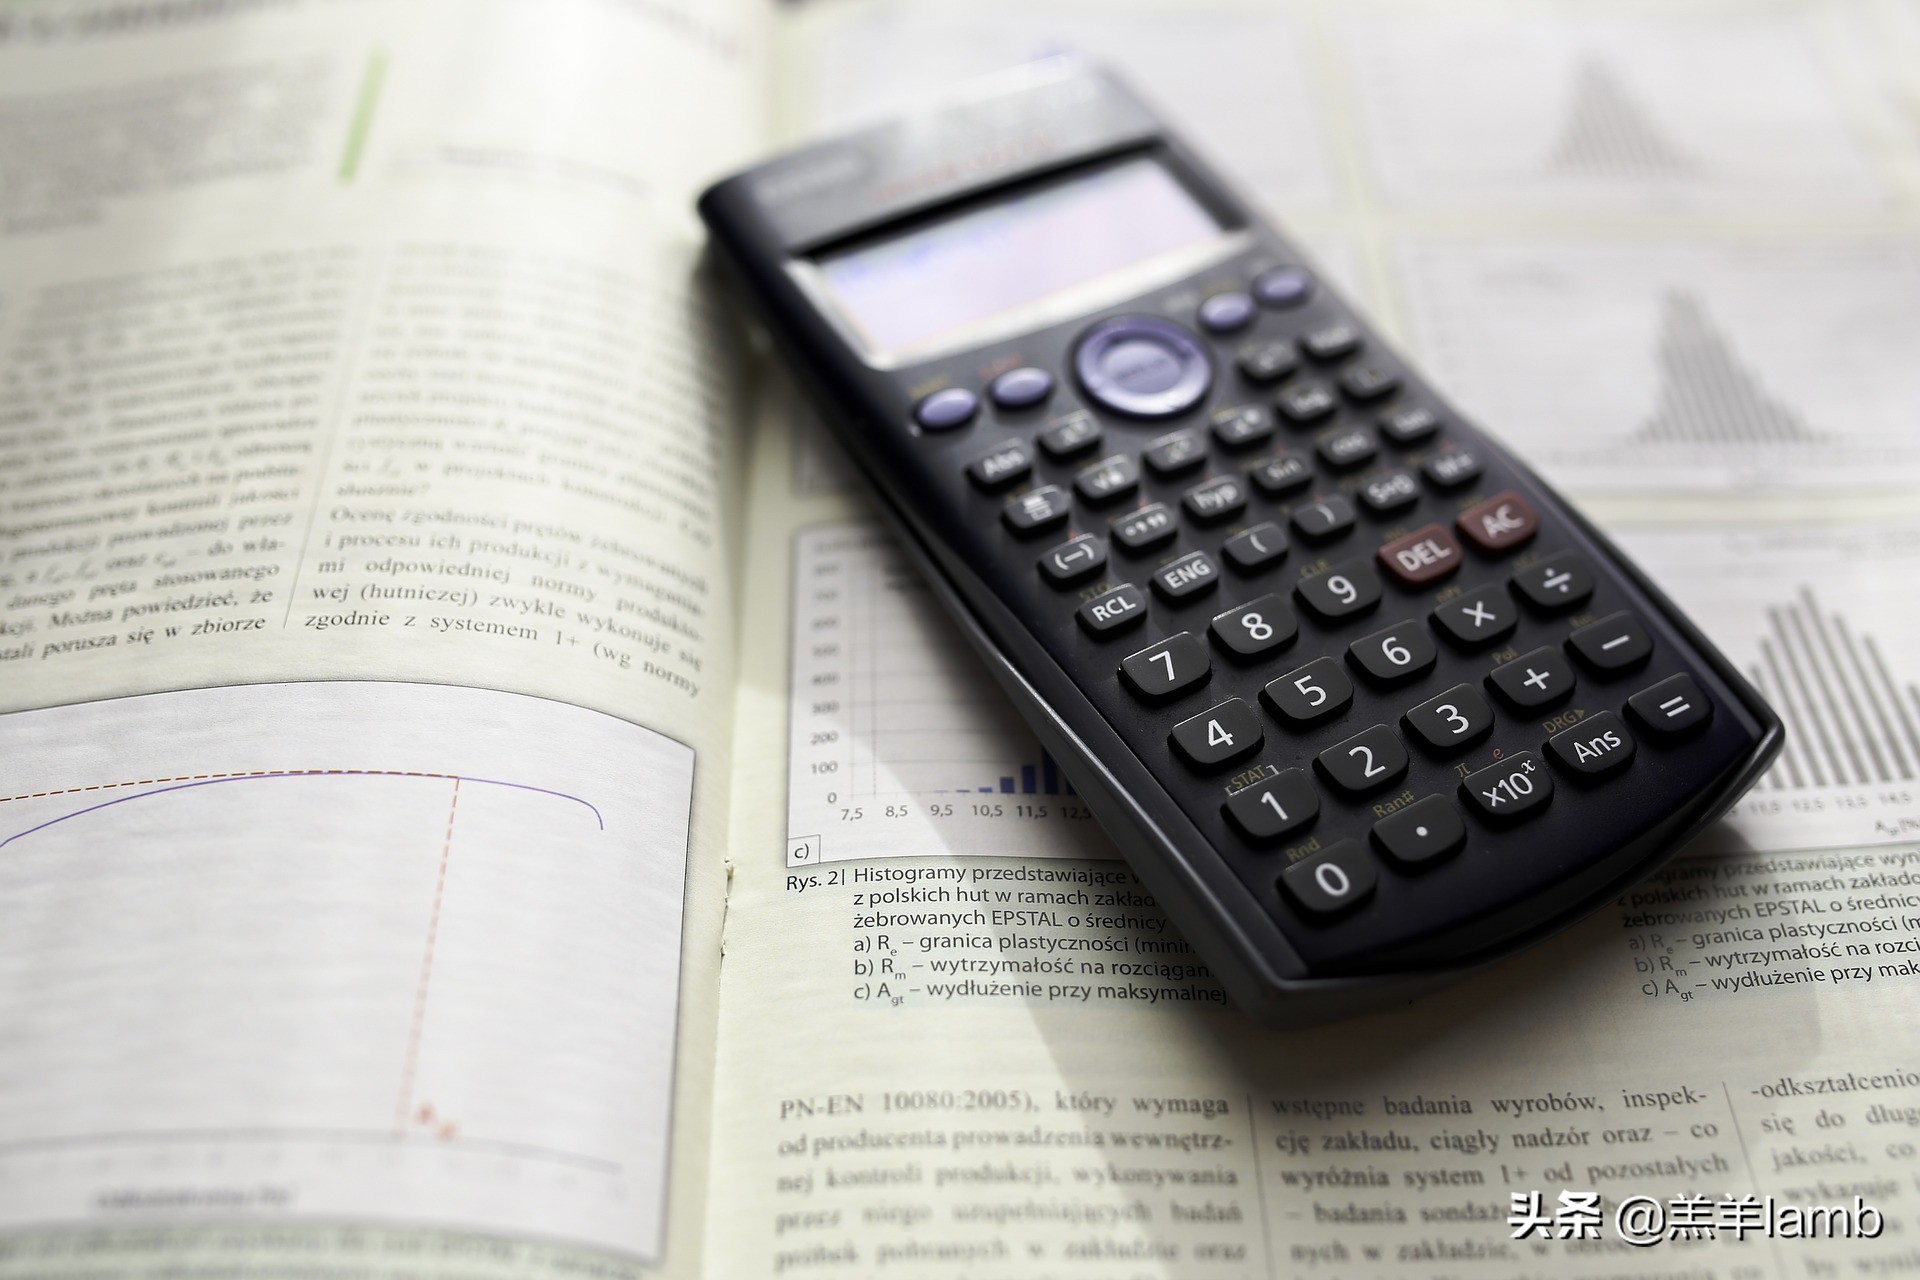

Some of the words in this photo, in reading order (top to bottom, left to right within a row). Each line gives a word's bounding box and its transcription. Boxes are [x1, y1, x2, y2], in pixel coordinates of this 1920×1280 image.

[331, 505, 395, 523] Ocenę
[401, 508, 507, 528] zgodności
[513, 520, 581, 543] prętów
[1482, 504, 1524, 539] AC
[324, 531, 332, 547] i
[338, 533, 421, 551] procesu
[430, 531, 461, 549] ich
[469, 539, 569, 567] produkcji
[1397, 538, 1450, 572] DEL
[152, 564, 280, 589] stosowanego
[318, 558, 346, 573] mi
[365, 557, 511, 584] odpowiedniej
[531, 575, 597, 602] normy
[1164, 559, 1211, 590] ENG
[1327, 575, 1357, 604] 9
[49, 607, 113, 628] Można
[122, 590, 239, 622] powiedzieć,
[249, 588, 274, 605] że
[1091, 596, 1137, 623] RCL
[41, 633, 117, 660] porusza
[126, 626, 155, 645] się
[165, 625, 182, 638] w
[191, 616, 266, 636] zbiorze
[313, 582, 349, 603] wej
[361, 583, 478, 606] (hutniczej)
[489, 596, 566, 618] zwykle
[576, 612, 671, 654] wykonuje
[679, 649, 703, 672] się
[1241, 612, 1273, 640] 8
[305, 610, 390, 630] zgodnie
[405, 615, 416, 627] z
[430, 615, 538, 641] systemem
[556, 631, 579, 647] 1+
[593, 642, 631, 668] (wg
[642, 659, 699, 698] normy
[1149, 650, 1176, 682] 7
[1381, 636, 1412, 666] 6
[1293, 675, 1327, 707] 5
[1208, 719, 1234, 747] 4
[1435, 704, 1470, 734] 3
[811, 731, 838, 745] 200
[1573, 730, 1622, 764] Ans
[811, 762, 838, 774] 100
[1348, 745, 1386, 778] 2
[827, 792, 837, 803] 0
[1261, 791, 1288, 820] 1
[1372, 789, 1415, 819] Ran#
[840, 807, 863, 822] 7,5
[885, 805, 908, 818] 8,5
[930, 804, 953, 817] 9,5
[971, 804, 1003, 818] 10,5
[1016, 804, 1048, 819] 11,5
[794, 843, 810, 859] c)
[1286, 838, 1321, 862] Rnd
[786, 875, 822, 893] Rys.
[854, 867, 966, 883] Histogramy
[972, 866, 1126, 886] przedstawiające
[1314, 862, 1350, 896] 0
[1724, 854, 1875, 880] przedstawiające
[853, 894, 864, 905] z
[870, 887, 950, 908] polskich
[957, 887, 989, 902] hut
[995, 890, 1011, 903] w
[1018, 890, 1089, 905] ramach
[1631, 887, 1710, 908] polskich
[1713, 884, 1749, 898] hut
[1752, 885, 1768, 897] w
[1774, 876, 1846, 895] ramach
[853, 909, 986, 928] żebrowanych
[992, 910, 1062, 927] EPSTAL
[1068, 915, 1080, 928] o
[1086, 912, 1167, 934] średnicy
[1622, 903, 1751, 928] żebrowanych
[1755, 900, 1826, 918] EPSTAL
[1830, 900, 1843, 912] o
[854, 936, 871, 953] a)
[919, 933, 993, 953] granica
[1000, 933, 1129, 954] plastyczności
[1628, 935, 1646, 951] a)
[1692, 927, 1764, 949] granica
[1768, 916, 1898, 943] plastyczności
[854, 959, 874, 977] b)
[930, 957, 1074, 976] wytrzymałość
[1081, 962, 1104, 975] na
[1634, 957, 1655, 974] b)
[1705, 942, 1842, 970] wytrzymałość
[1845, 944, 1870, 957] na
[854, 983, 871, 1001] c)
[927, 980, 1042, 1000] wydłużenie
[1050, 985, 1091, 1001] przy
[1098, 983, 1228, 1006] maksymalnej
[1642, 980, 1658, 997] c)
[1711, 967, 1826, 993] wydłużenie
[1830, 966, 1872, 984] przy
[780, 1093, 863, 1120] PN-EN
[884, 1088, 1039, 1112] 10080:2005),
[1055, 1090, 1116, 1118] który
[1132, 1096, 1229, 1120] wymaga
[1273, 1099, 1364, 1120] wstępne
[1384, 1094, 1472, 1116] badania
[1491, 1092, 1604, 1118] wyrobów,
[1622, 1086, 1707, 1111] inspek-
[1761, 1113, 1795, 1136] się
[1815, 1109, 1845, 1129] do
[778, 1133, 807, 1157] od
[813, 1129, 947, 1158] producenta
[953, 1126, 1104, 1152] prowadzenia
[1111, 1130, 1232, 1153] wewnętrz-
[1275, 1130, 1310, 1156] cję
[1322, 1130, 1419, 1152] zakładu,
[1429, 1129, 1499, 1155] ciągły
[1512, 1126, 1590, 1148] nadzór
[1602, 1128, 1653, 1144] oraz
[1690, 1123, 1718, 1138] co
[1771, 1142, 1868, 1174] jakości,
[1886, 1143, 1917, 1159] co
[1073, 1163, 1238, 1191] wykonywania
[1281, 1165, 1390, 1194] wyróżnia
[1403, 1168, 1484, 1193] system
[1544, 1162, 1573, 1182] od
[1587, 1153, 1728, 1186] pozostałych
